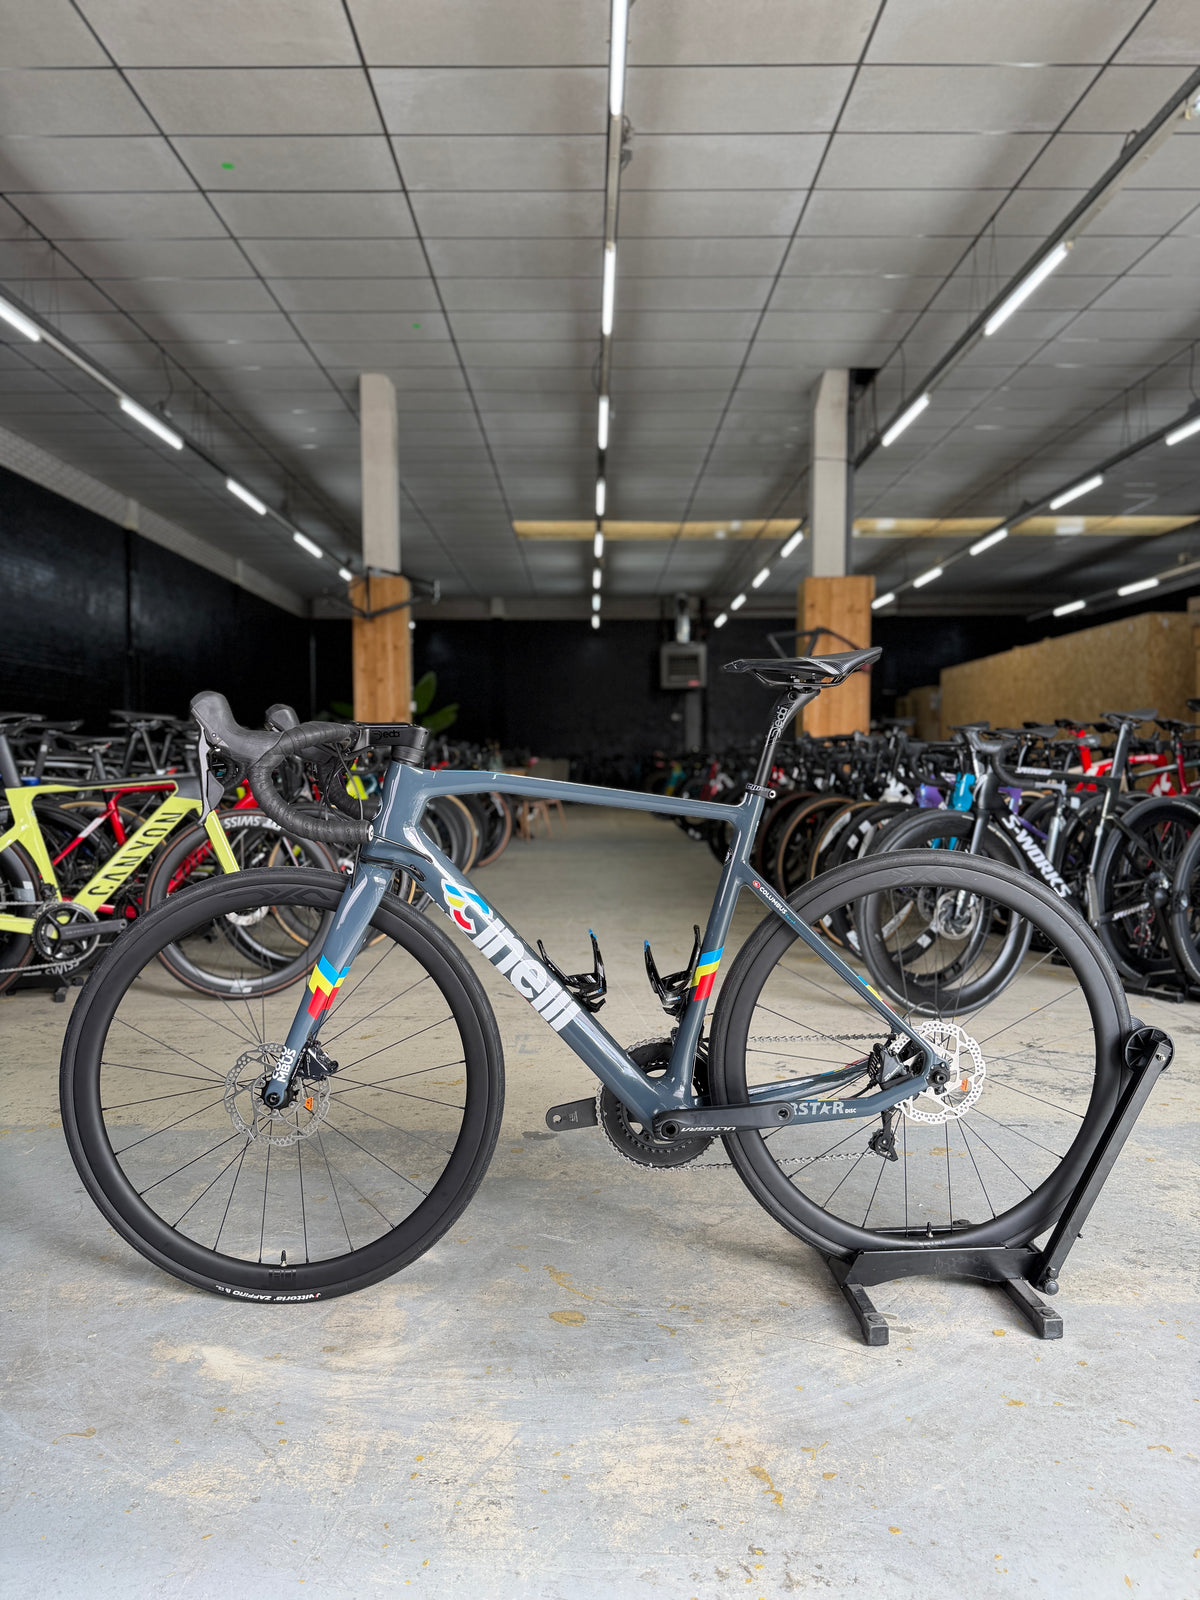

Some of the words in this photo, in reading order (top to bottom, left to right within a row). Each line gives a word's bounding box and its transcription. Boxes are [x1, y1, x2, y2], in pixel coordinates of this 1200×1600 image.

[223, 815, 261, 830] SWISS
[87, 811, 183, 897] CANYON
[1001, 813, 1073, 899] S-WORKS
[758, 885, 789, 916] COLUMBUS
[276, 1048, 297, 1083] MBUS
